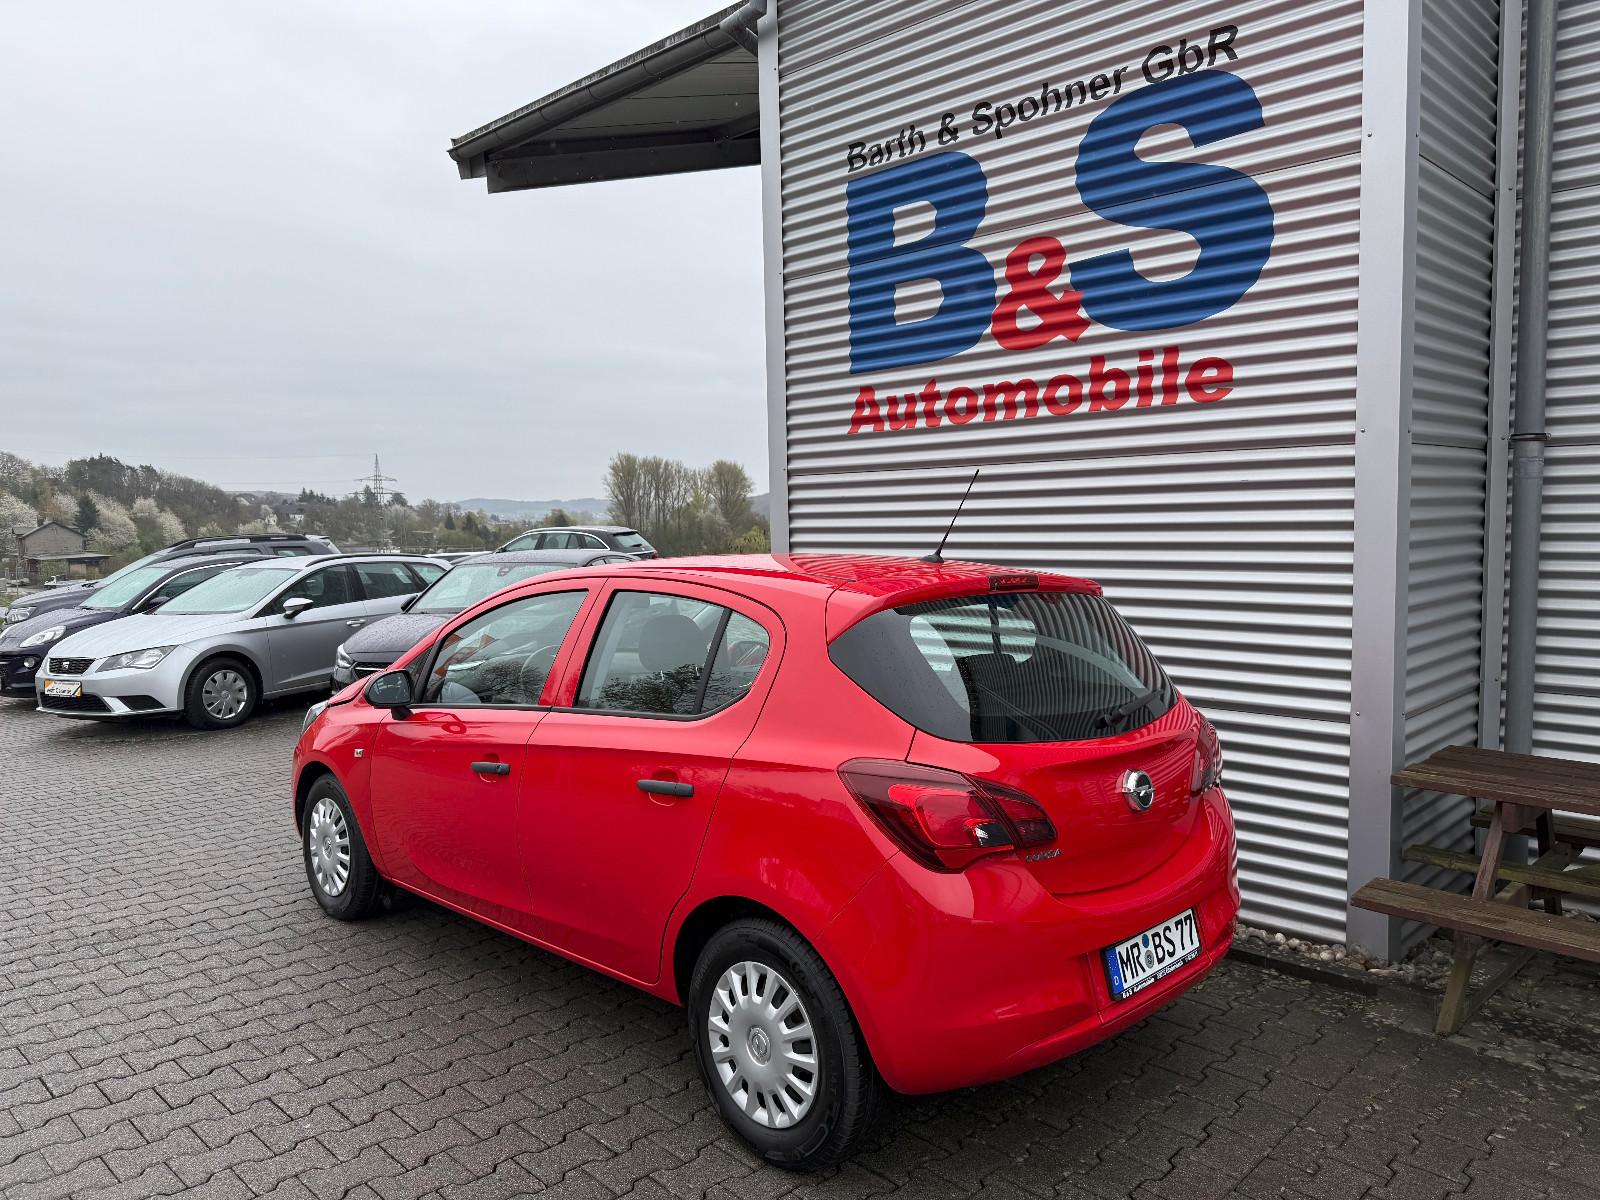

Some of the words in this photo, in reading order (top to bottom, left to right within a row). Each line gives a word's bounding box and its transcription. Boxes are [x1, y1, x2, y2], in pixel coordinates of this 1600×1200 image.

[847, 126, 926, 173] Barth
[937, 112, 960, 146] &
[971, 65, 1128, 140] Spohner
[1141, 24, 1240, 85] GbR
[847, 346, 1234, 436] Automobile
[1117, 941, 1147, 984] MR
